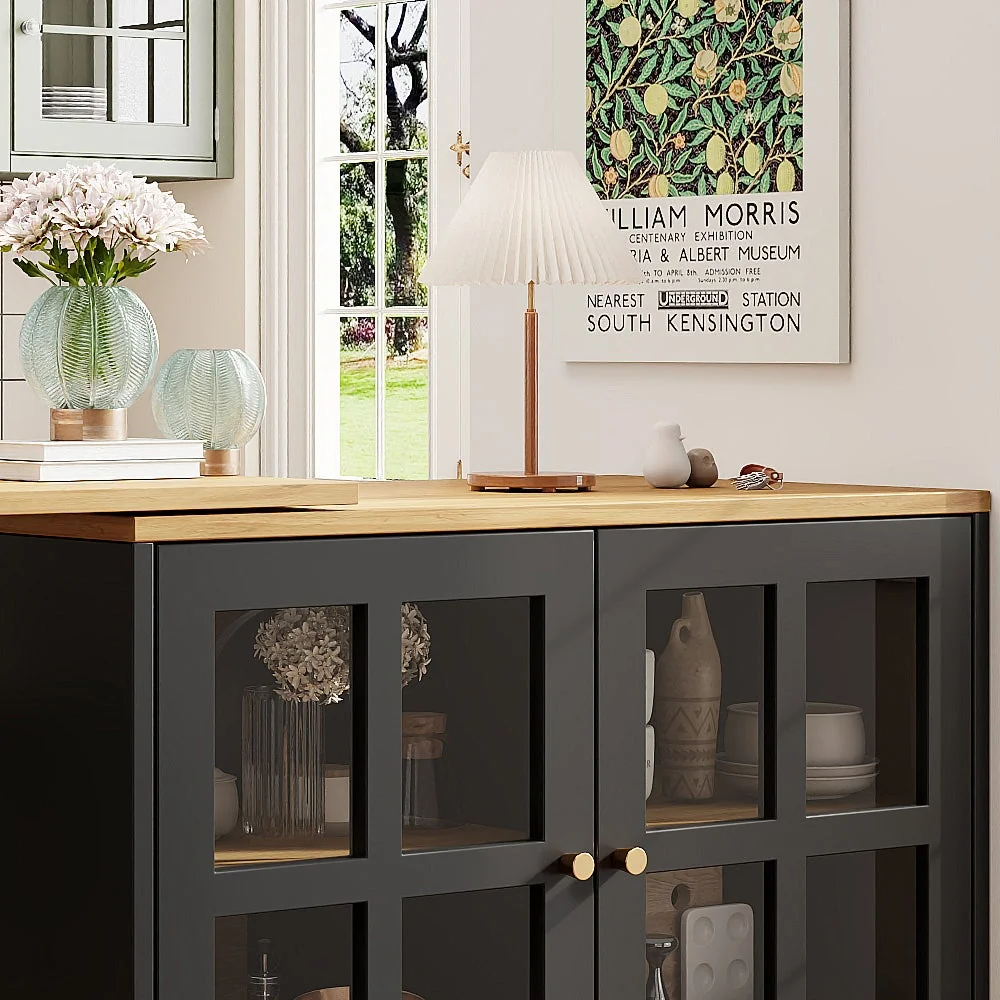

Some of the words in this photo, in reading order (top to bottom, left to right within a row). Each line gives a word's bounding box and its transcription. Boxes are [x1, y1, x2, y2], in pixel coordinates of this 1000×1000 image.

[605, 204, 686, 230] ILLIAM
[705, 200, 801, 227] MORRIS
[629, 232, 686, 243] CENTENARY
[694, 230, 753, 242] EXHIBITION
[660, 248, 669, 262] &
[679, 246, 730, 262] ALBERT
[738, 245, 801, 261] MUSEUM
[653, 269, 663, 277] TO
[704, 267, 741, 276] ADMISSION
[745, 267, 761, 275] FREE
[587, 293, 645, 308] NEAREST
[658, 290, 729, 308] UNDERGROUND
[742, 291, 801, 307] STATION
[587, 313, 651, 332] SOUTH
[667, 313, 801, 332] KENSINGTON
